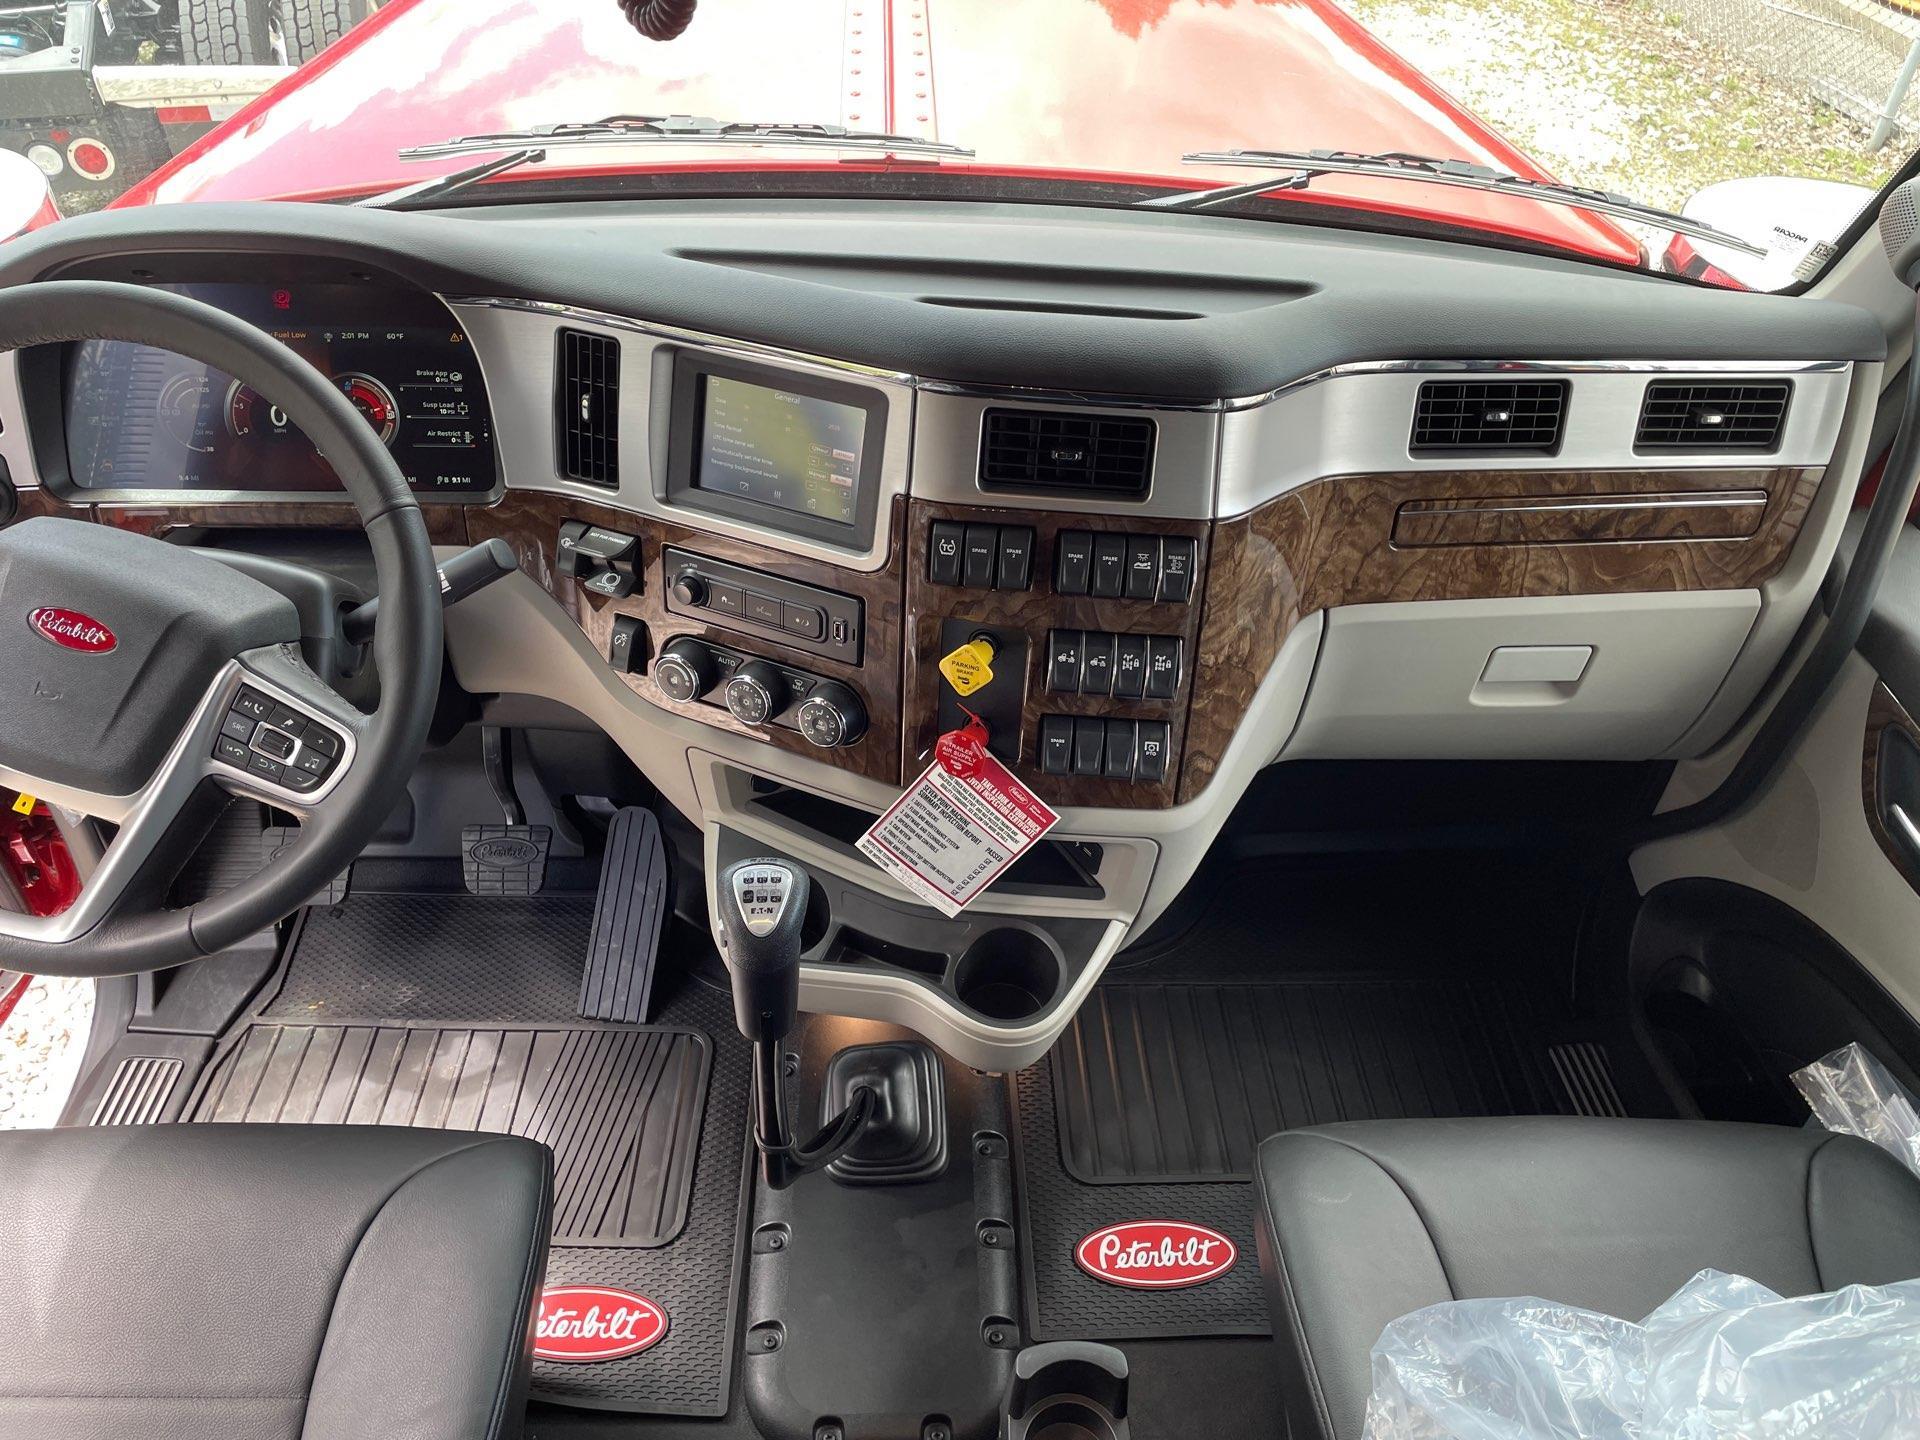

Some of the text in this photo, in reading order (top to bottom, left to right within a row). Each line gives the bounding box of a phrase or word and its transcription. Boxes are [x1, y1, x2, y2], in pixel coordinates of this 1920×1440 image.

[775, 393, 800, 404] General
[942, 544, 953, 552] TC
[38, 610, 110, 644] Peterbilt
[717, 656, 736, 667] AUTO
[952, 660, 980, 672] PARKING
[956, 668, 973, 676] BRAKE
[232, 722, 246, 733] SRC
[949, 743, 973, 756] TRAILER
[953, 750, 976, 763] SUPPLY
[979, 778, 994, 792] TAKE
[993, 790, 1010, 805] LOOK
[1005, 801, 1015, 810] AT
[1011, 806, 1027, 820] YOUR
[1023, 816, 1041, 833] TRUCK
[981, 789, 1037, 838] INSPECTION CERTIFICATE
[916, 789, 982, 846] SUMMARY INSPECTION REPORT
[924, 809, 939, 822] CHECKS
[949, 807, 971, 827] MACHINE
[896, 817, 916, 834] OPERATION
[913, 832, 922, 840] AND
[920, 837, 939, 853] CONTROLS
[897, 829, 912, 841] REVIEW
[902, 812, 921, 828] SOFTWARE
[918, 825, 928, 834] AND
[925, 831, 947, 850] TECHNOLOGY
[916, 814, 926, 822] AND
[923, 819, 947, 840] MAINTENANCE
[945, 837, 960, 850] SYSTEM
[984, 846, 1003, 862] PASSED
[934, 868, 954, 884] INSPECTION
[1099, 1234, 1221, 1270] Peterbilt
[537, 1300, 651, 1340] eterbilt
